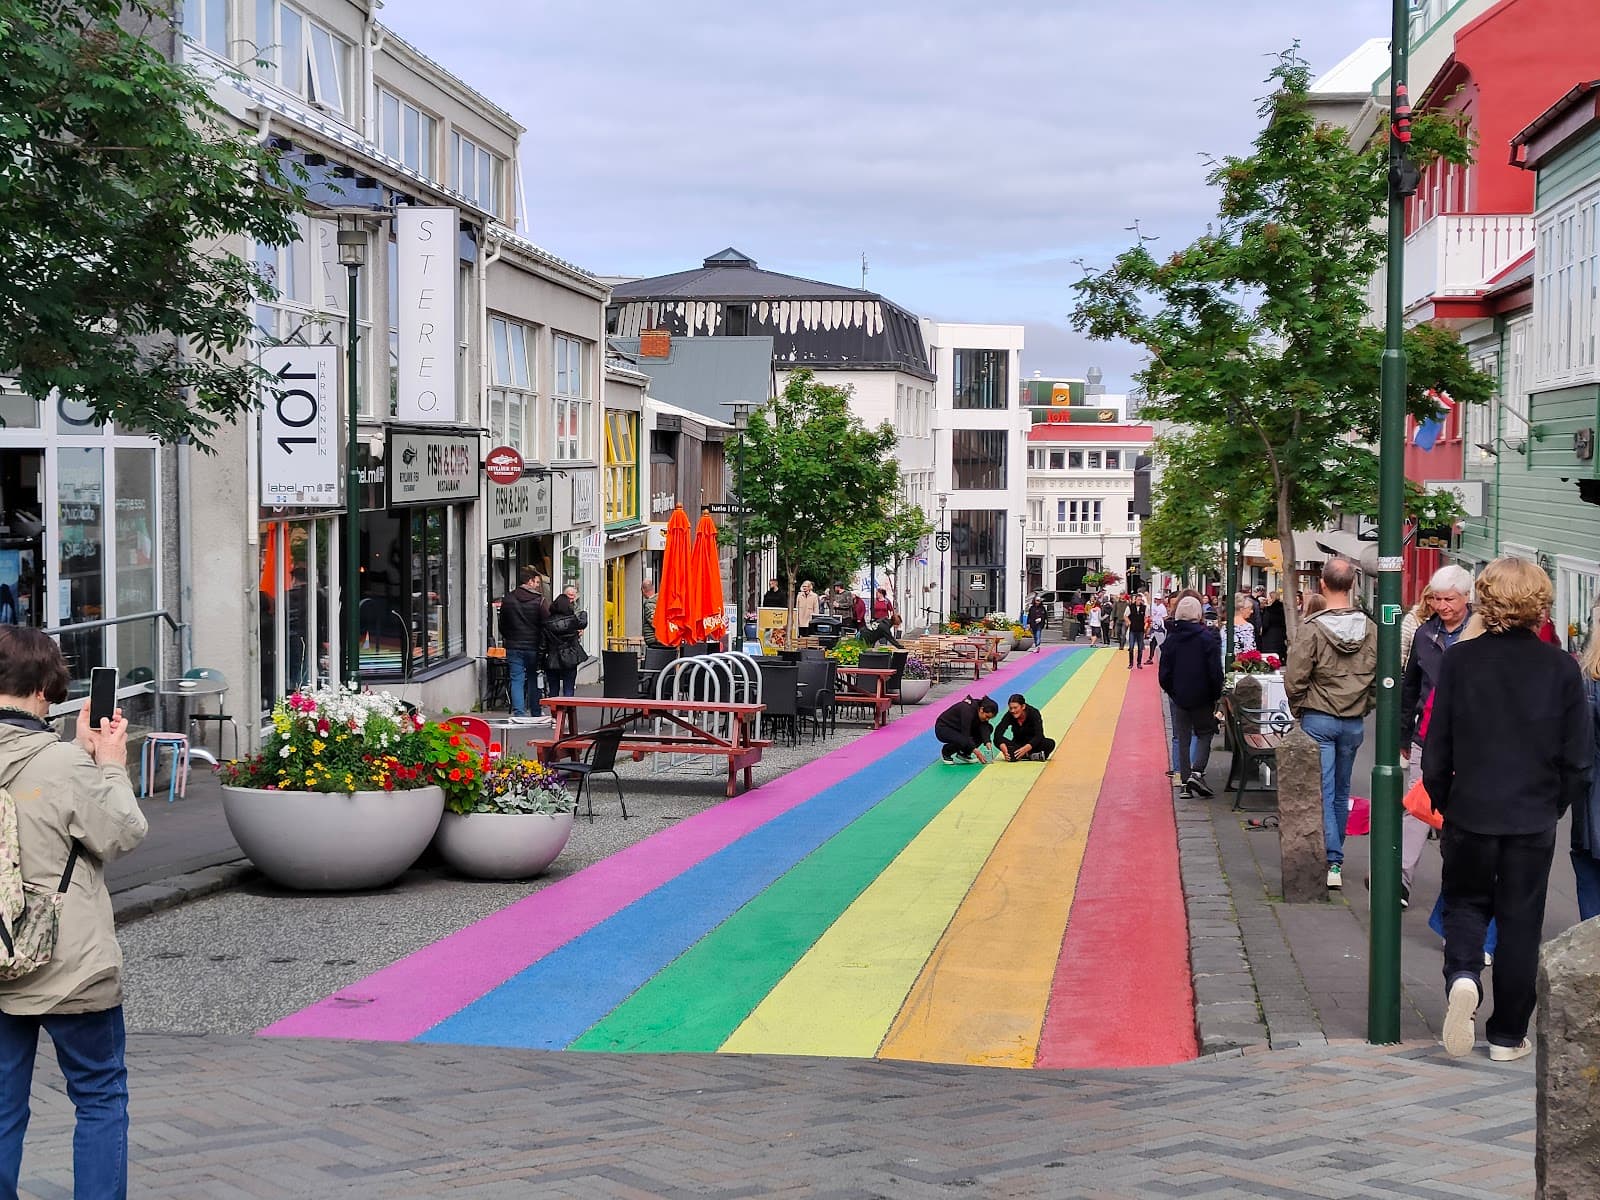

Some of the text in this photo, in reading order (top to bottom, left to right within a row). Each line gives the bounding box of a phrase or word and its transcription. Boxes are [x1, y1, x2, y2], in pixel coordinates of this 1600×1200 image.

[276, 361, 317, 455] 101
[1047, 408, 1070, 422] loft
[427, 443, 469, 477] FISH & CHIPS
[437, 479, 460, 493] RESTAURANT
[495, 485, 529, 516] FISH & CHIPS
